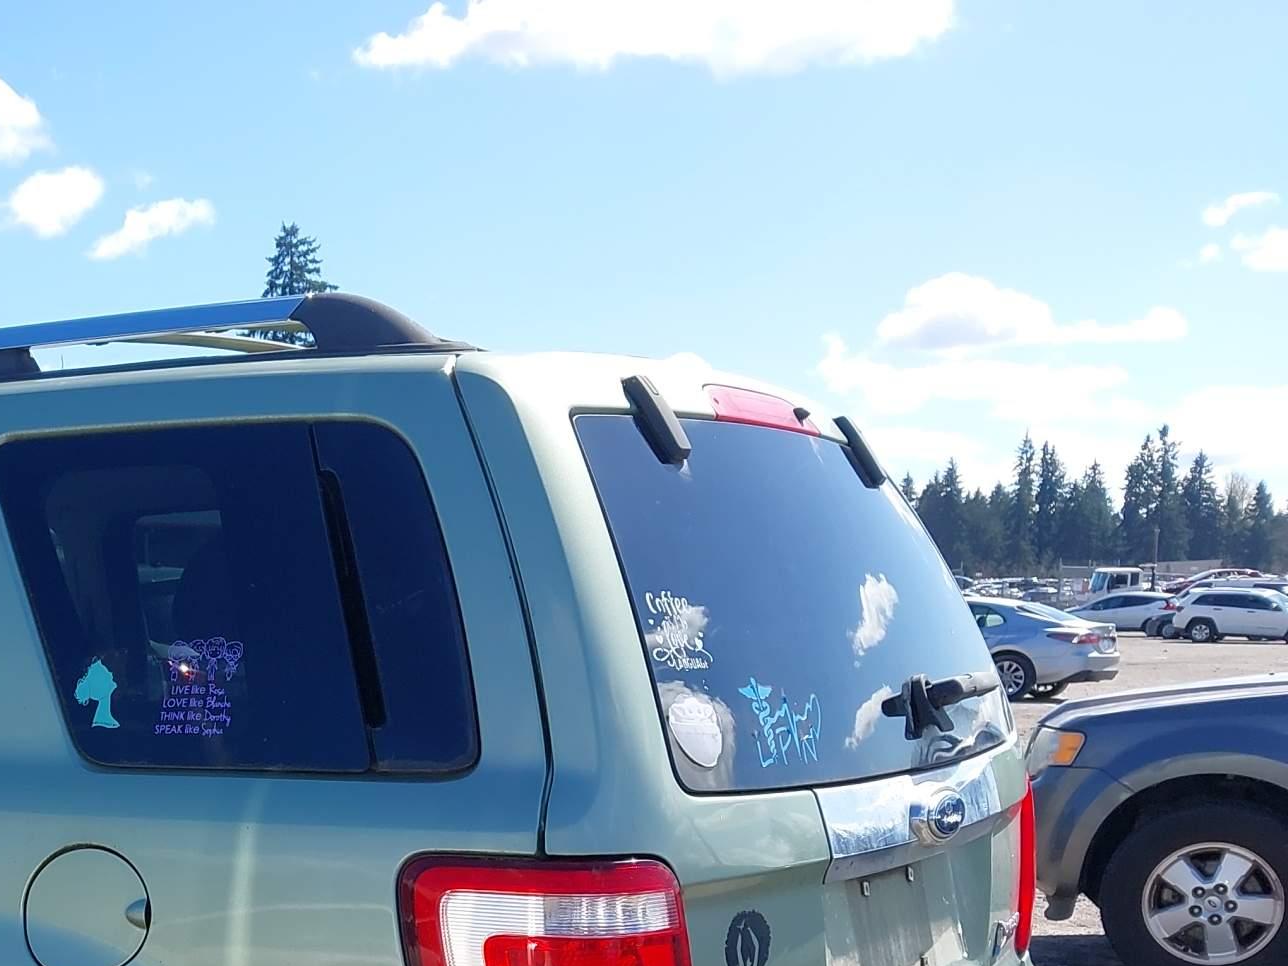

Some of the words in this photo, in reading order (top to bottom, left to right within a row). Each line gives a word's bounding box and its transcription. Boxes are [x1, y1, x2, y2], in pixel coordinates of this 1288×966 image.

[646, 590, 691, 616] Coffee
[172, 684, 190, 695] LIVE
[191, 684, 206, 695] like
[162, 697, 188, 709] LOVE
[189, 697, 204, 708] like
[160, 711, 185, 721] THINK
[187, 710, 201, 721] like
[154, 724, 183, 735] SPEAK
[184, 724, 200, 734] like
